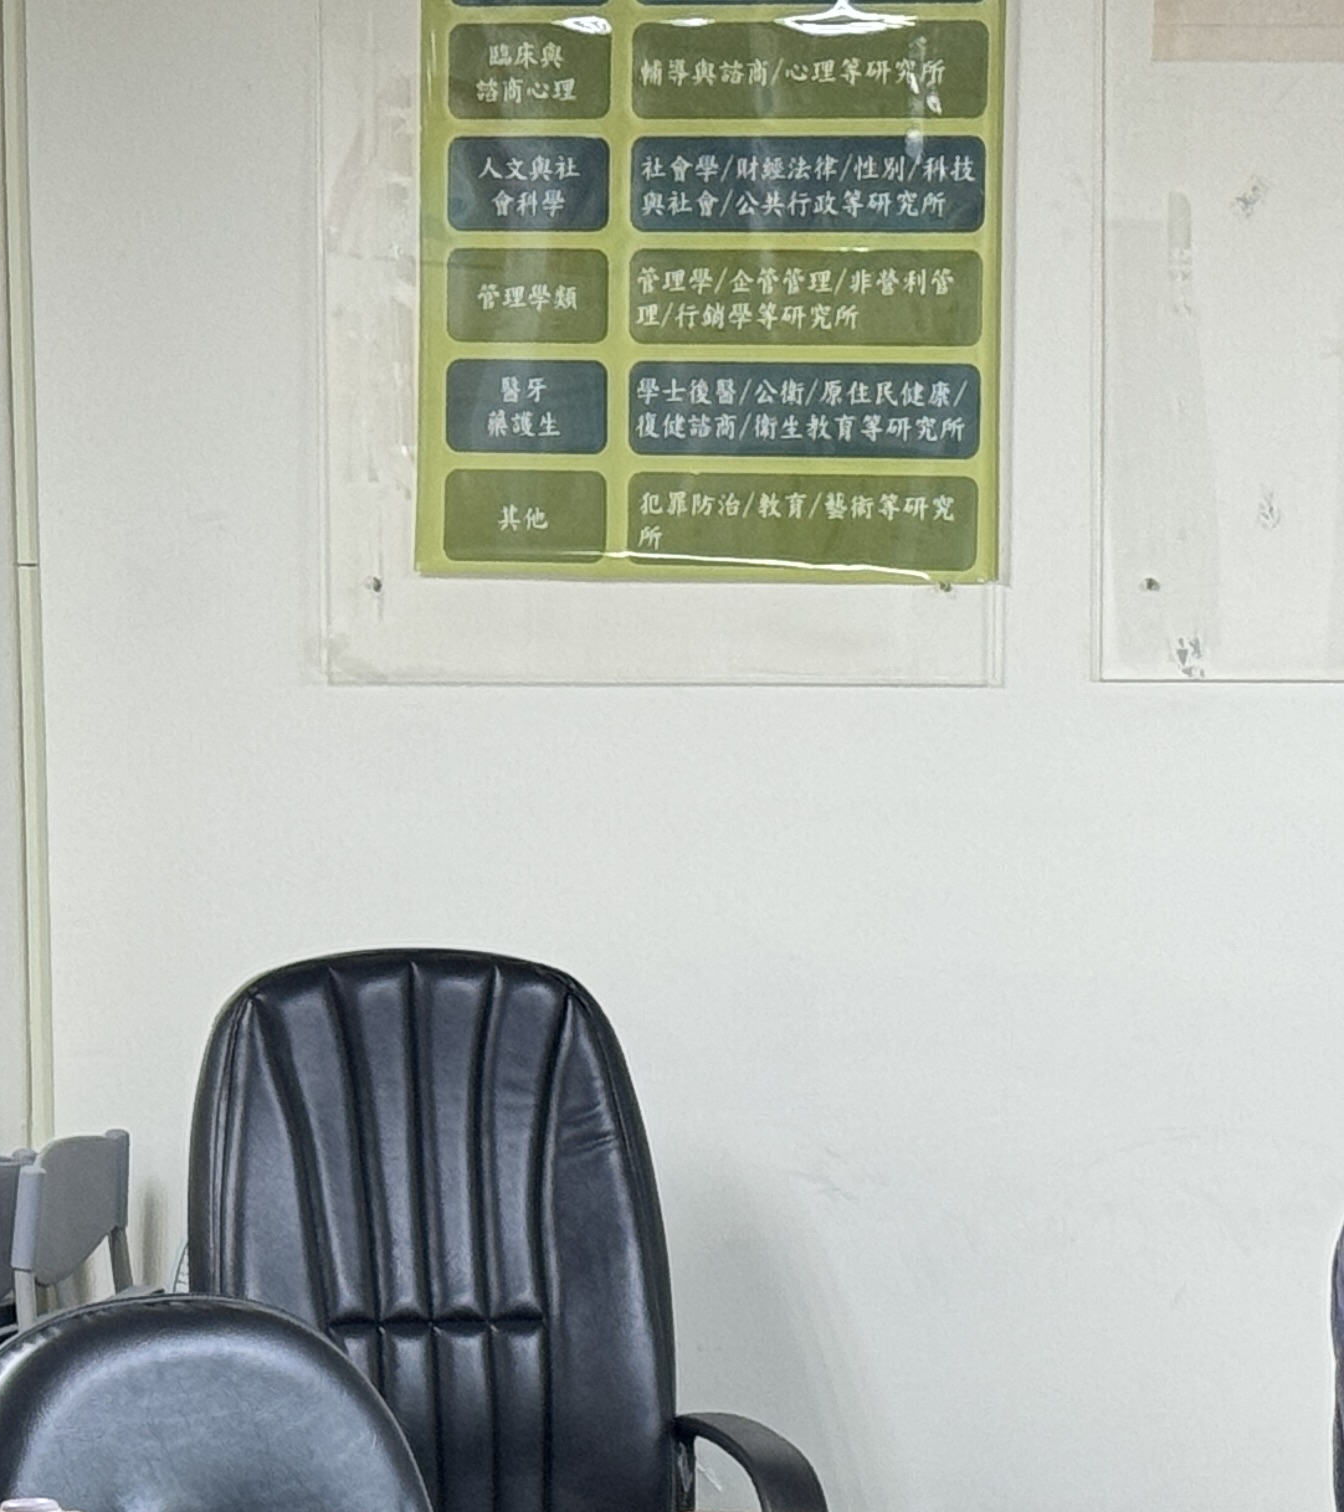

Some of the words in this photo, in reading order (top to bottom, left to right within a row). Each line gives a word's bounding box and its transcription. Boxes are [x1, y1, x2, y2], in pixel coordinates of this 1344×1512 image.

[488, 41, 565, 69] 臨床與
[640, 57, 946, 88] 輔導與諮商/心理等研究所
[476, 77, 577, 103] 諮商心理
[478, 155, 581, 182] 人文與社
[641, 153, 977, 183] 社會學/財經法律/性別/科技
[492, 189, 566, 217] 會科學
[641, 188, 947, 218] 與社會/公共行政等研究所
[637, 266, 955, 296] 管理學/企管管理/非營利管
[477, 283, 578, 312] 管理學類
[636, 301, 859, 331] 理/行銷學等研究所
[501, 376, 547, 402] 醫牙
[636, 378, 969, 408] 學士後醫/公衛/原住民健康/
[487, 408, 561, 438] 藥護生
[636, 412, 965, 442] 復健諮商/衛生教育等研究所
[498, 504, 549, 531] 其他
[639, 491, 955, 521] 犯罪防治/教育/藝術等研究
[638, 525, 663, 550] 所
